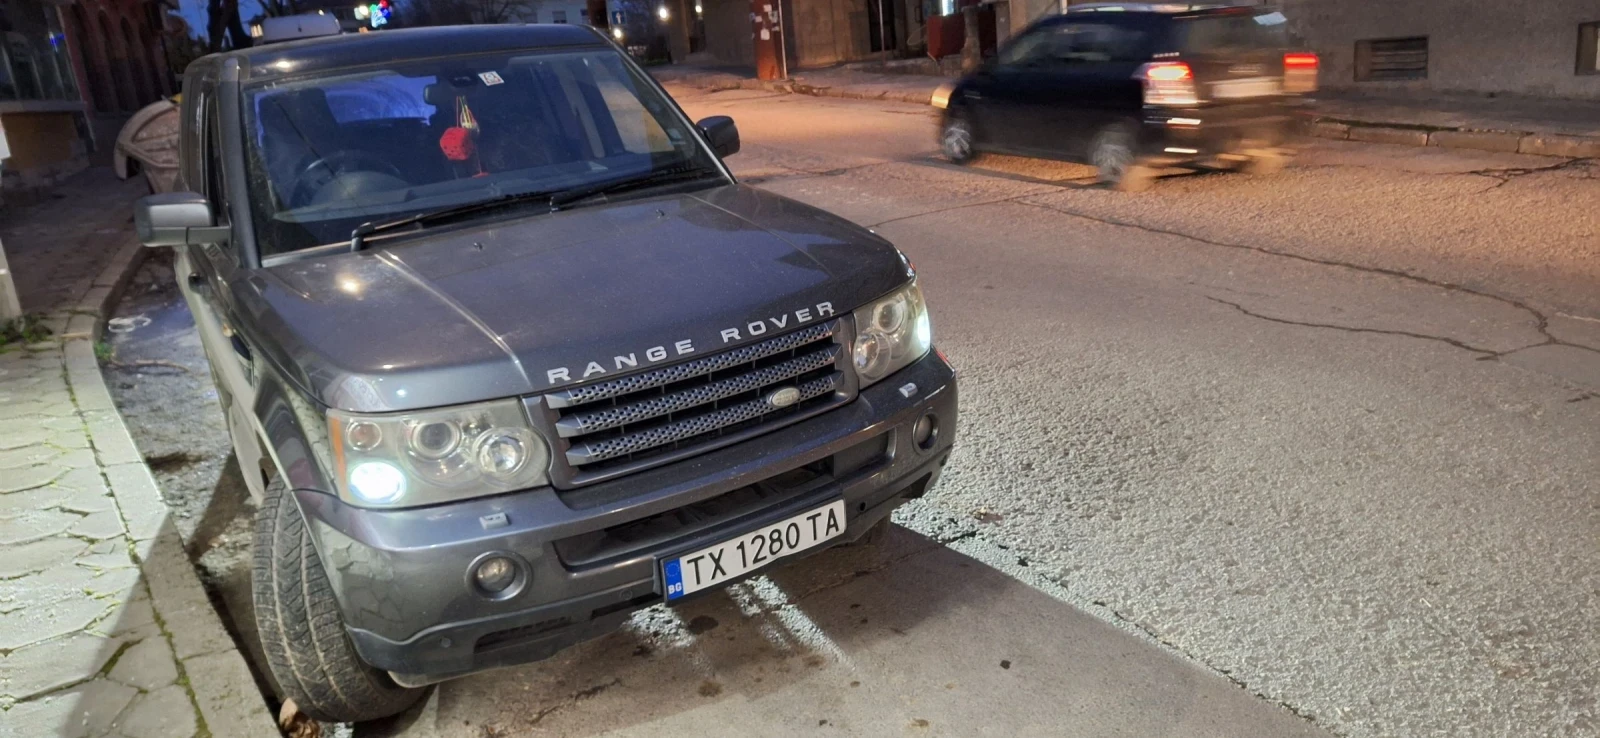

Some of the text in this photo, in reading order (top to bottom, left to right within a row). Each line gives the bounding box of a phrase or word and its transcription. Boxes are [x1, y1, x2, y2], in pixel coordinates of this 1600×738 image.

[547, 301, 835, 384] RANGE ROVER
[686, 508, 840, 585] TX 1280 TA
[667, 582, 682, 594] BG
